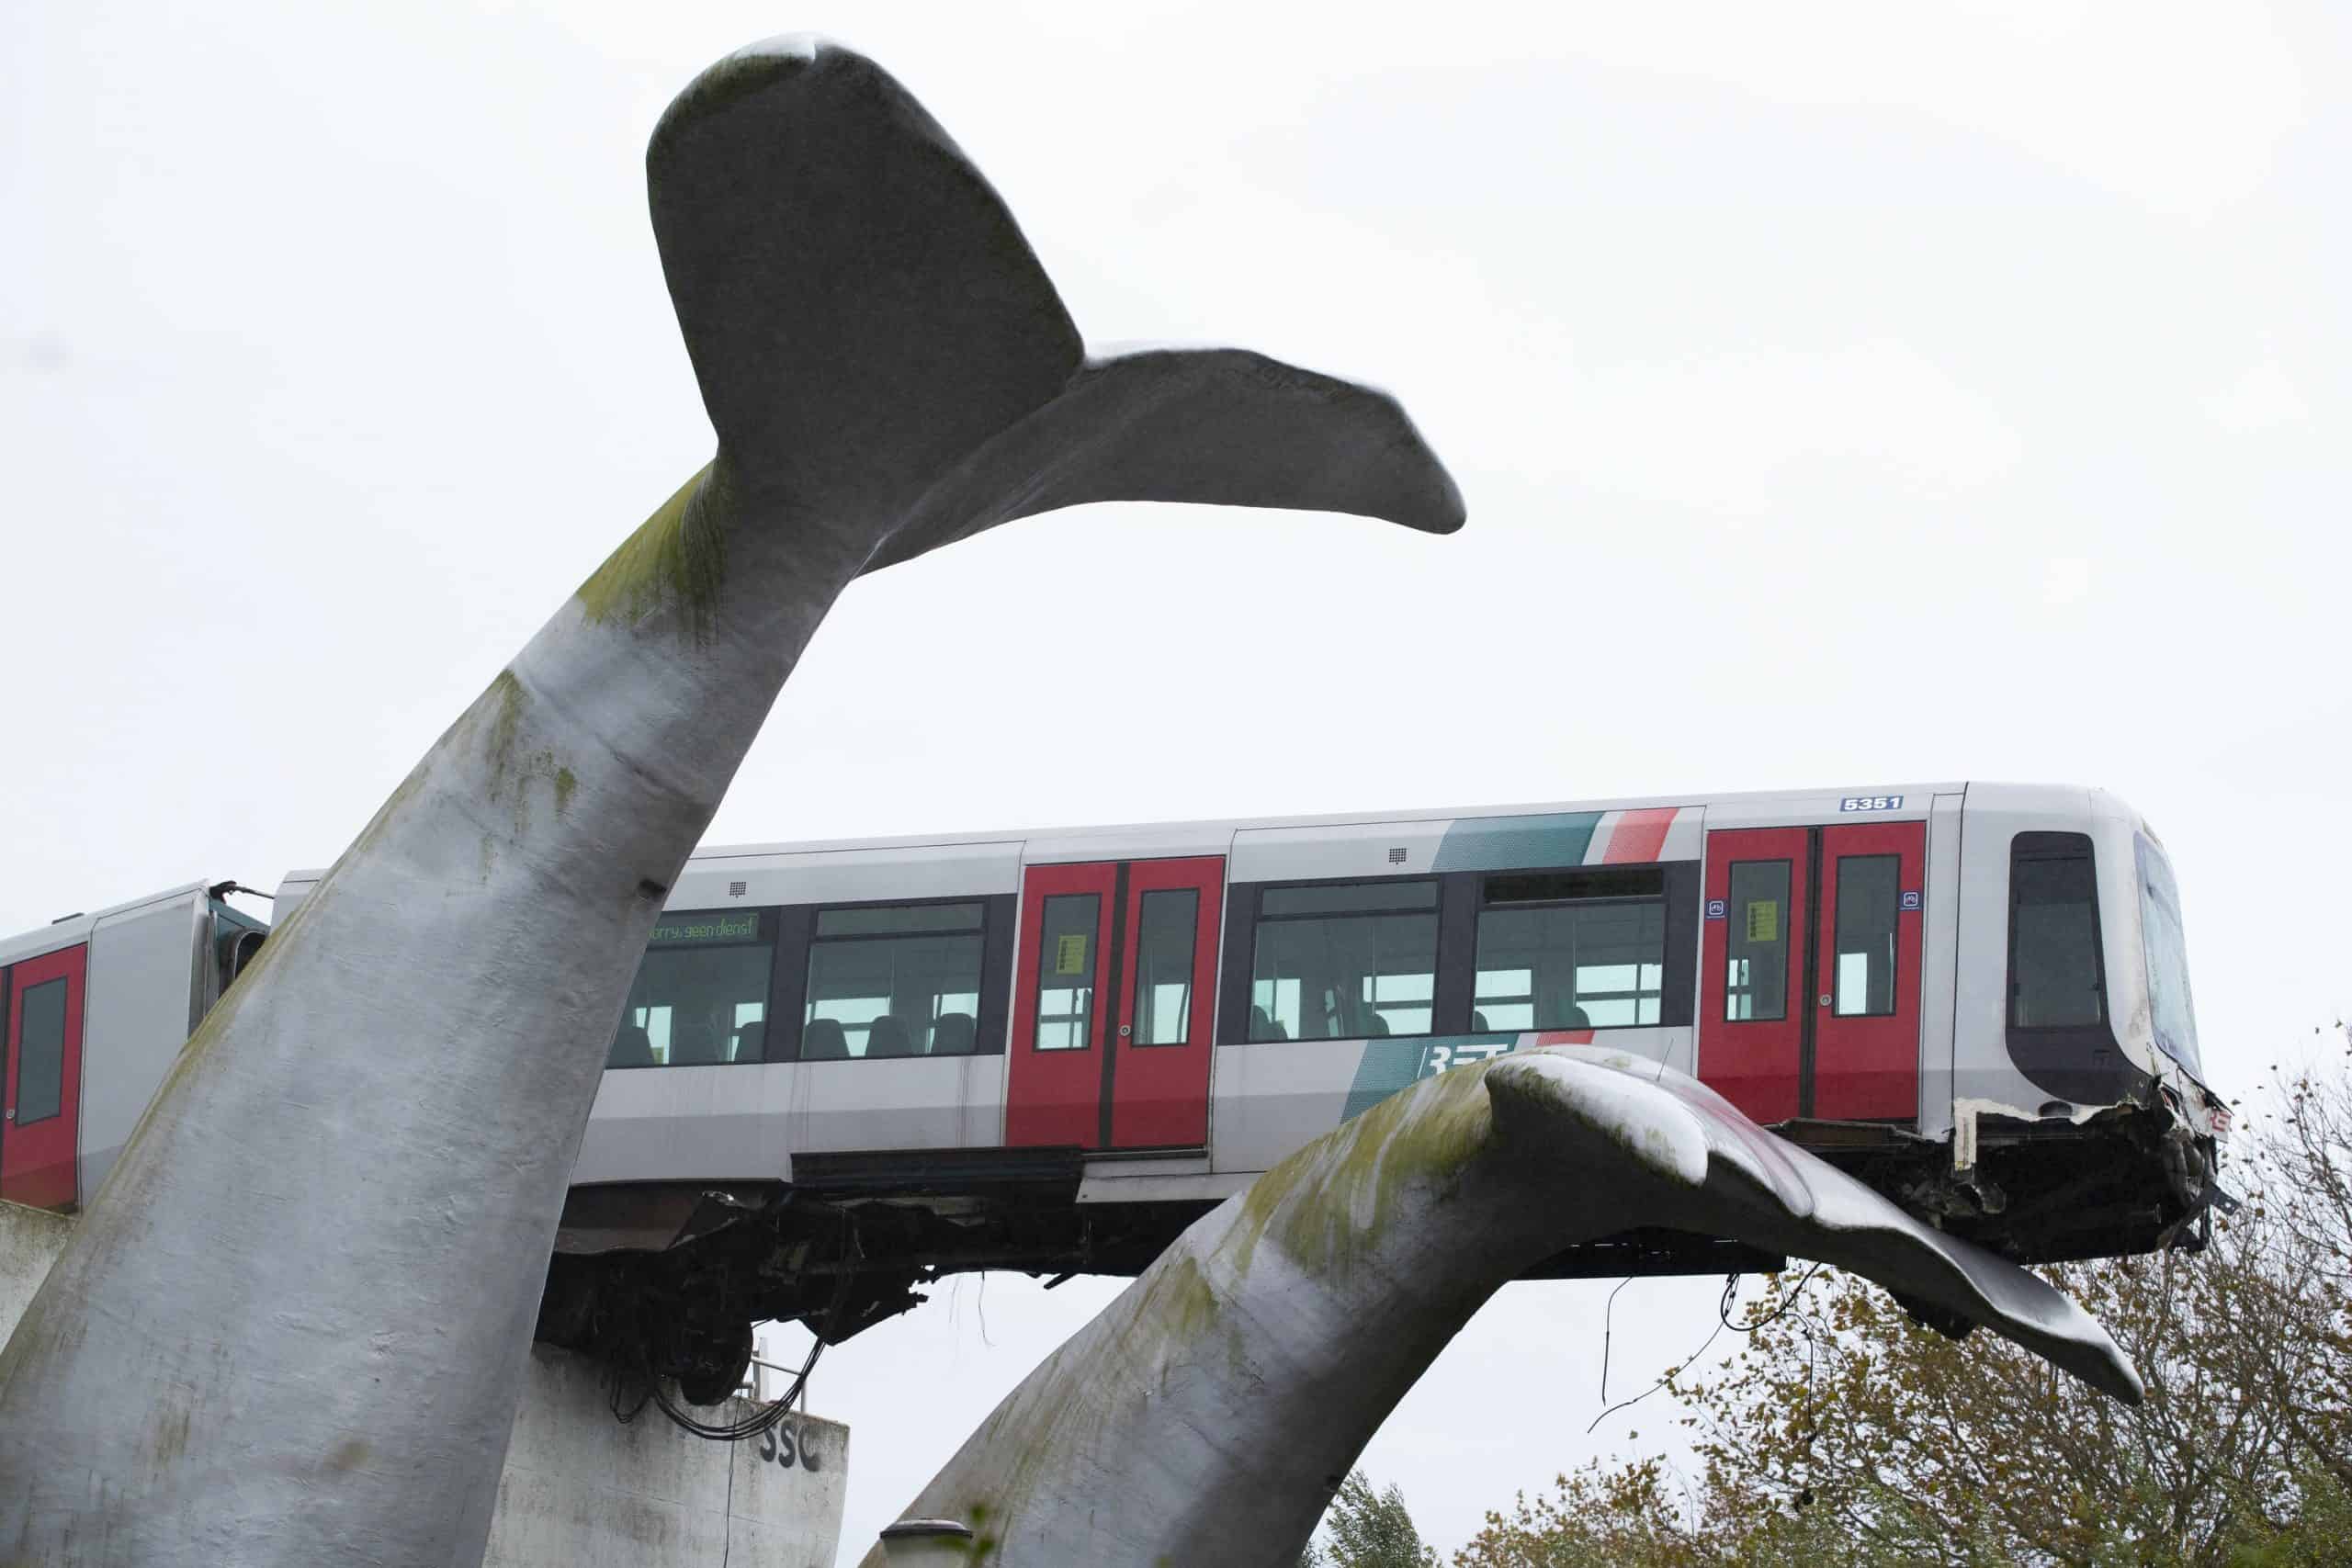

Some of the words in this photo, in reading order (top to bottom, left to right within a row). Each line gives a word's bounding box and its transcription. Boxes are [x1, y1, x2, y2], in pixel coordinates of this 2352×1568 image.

[1844, 797, 1901, 810] 5351
[684, 924, 714, 938] geen
[716, 918, 754, 935] dienst
